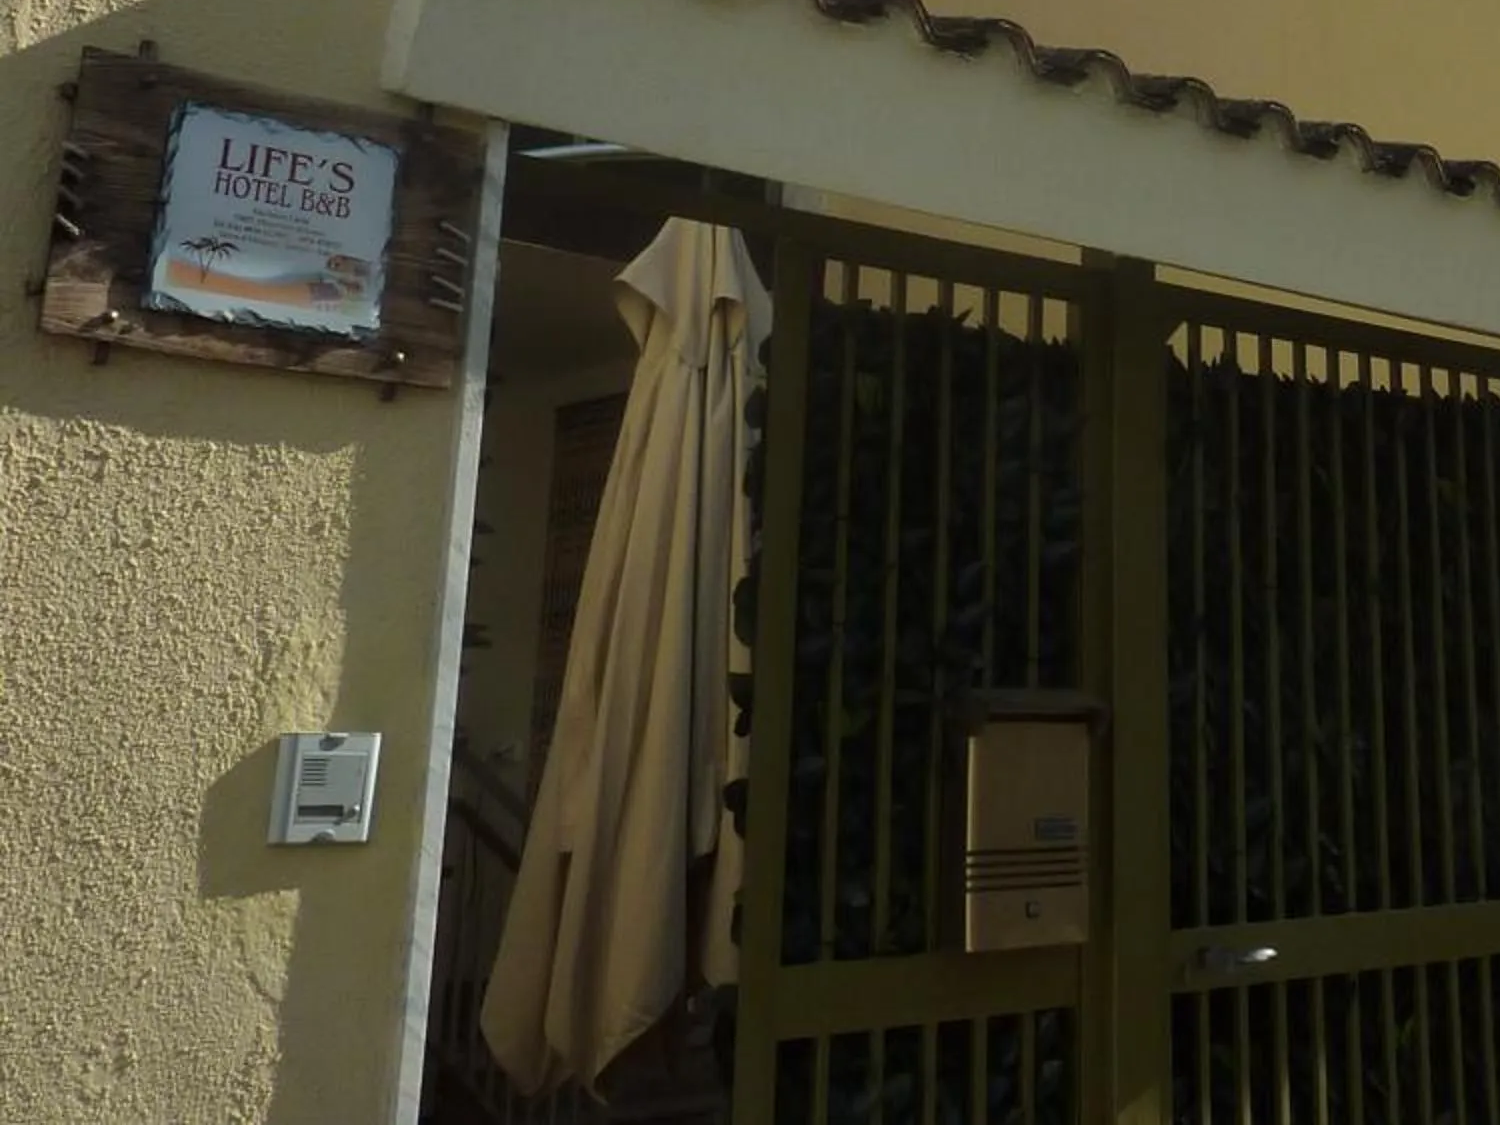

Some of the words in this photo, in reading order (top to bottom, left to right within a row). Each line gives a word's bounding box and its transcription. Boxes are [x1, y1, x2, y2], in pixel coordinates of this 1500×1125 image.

[219, 137, 355, 194] LIFE'S
[213, 170, 291, 209] HOTEL
[300, 188, 351, 219] B&B
